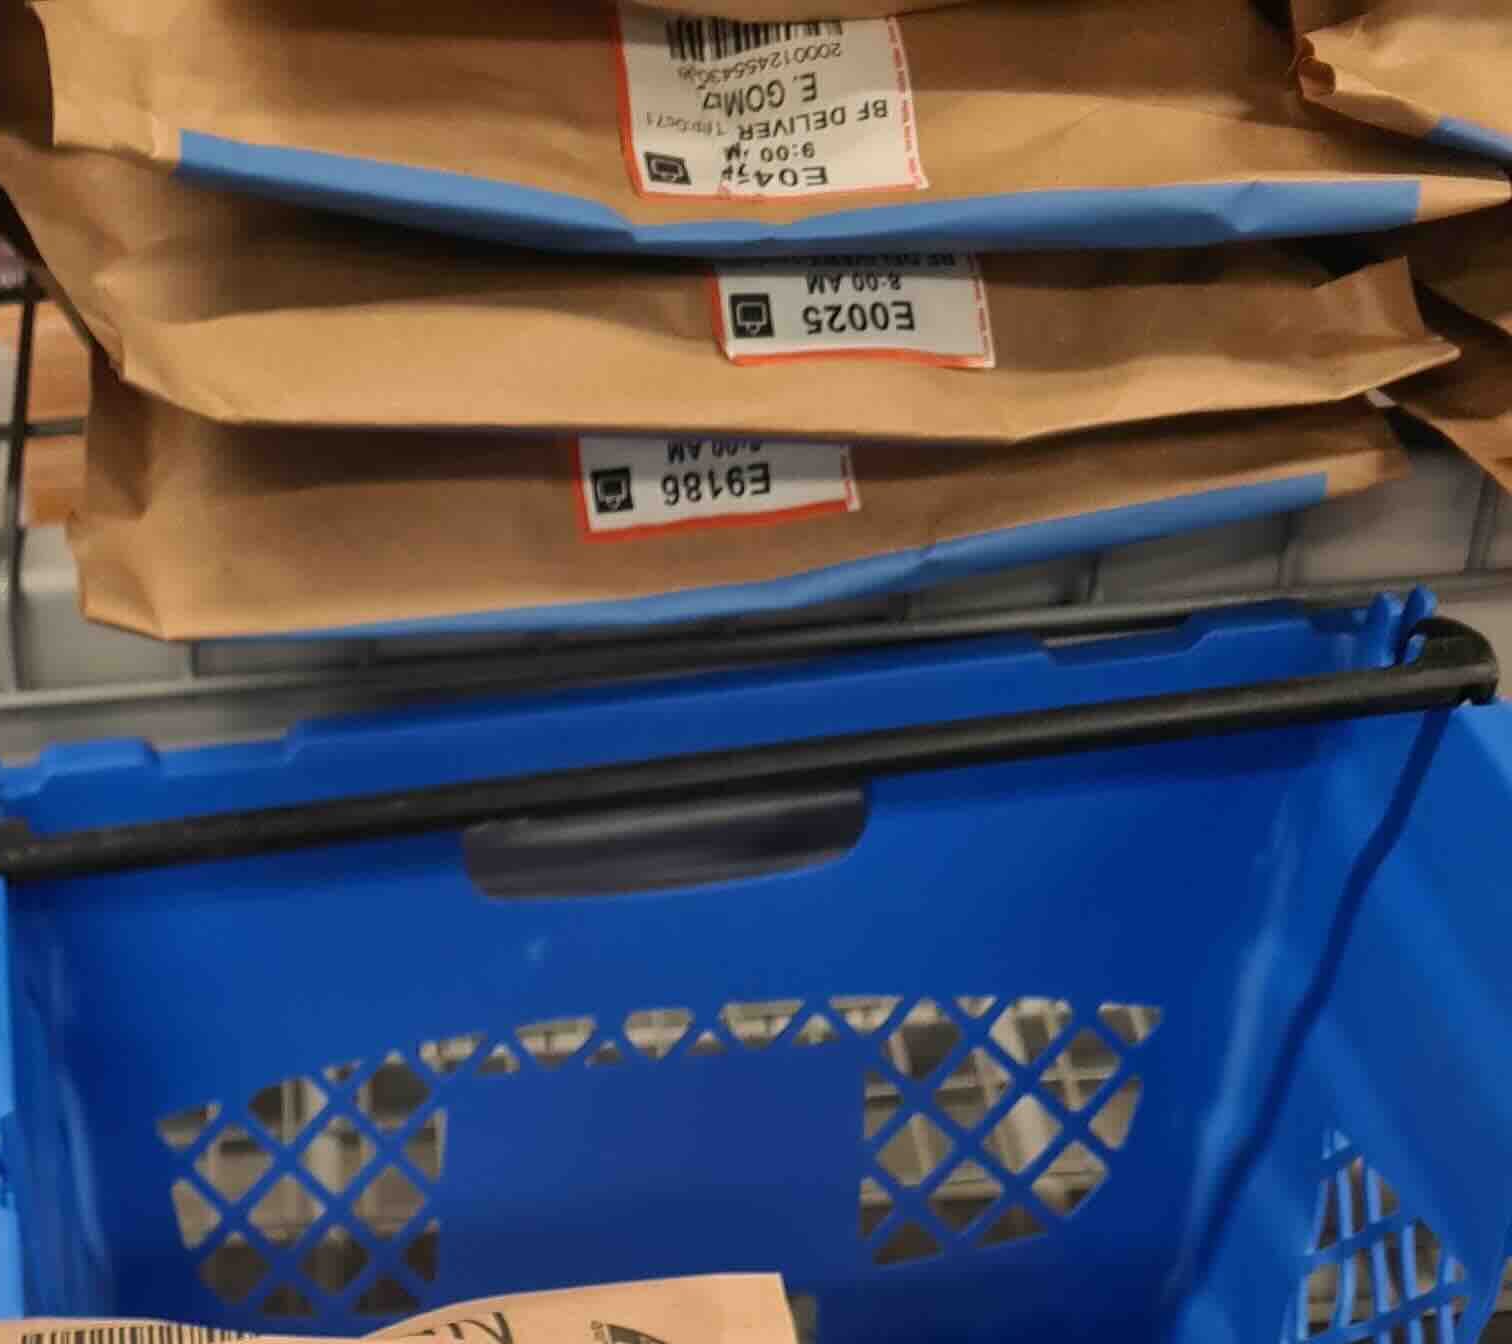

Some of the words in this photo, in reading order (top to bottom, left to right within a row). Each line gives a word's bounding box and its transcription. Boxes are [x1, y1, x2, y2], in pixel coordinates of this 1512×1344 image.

[793, 71, 817, 102] E.
[856, 98, 889, 122] BF
[761, 141, 816, 163] 9:00
[805, 270, 842, 294] AM
[802, 300, 916, 335] E0025
[667, 438, 702, 464] AM
[661, 462, 772, 507] E9186
